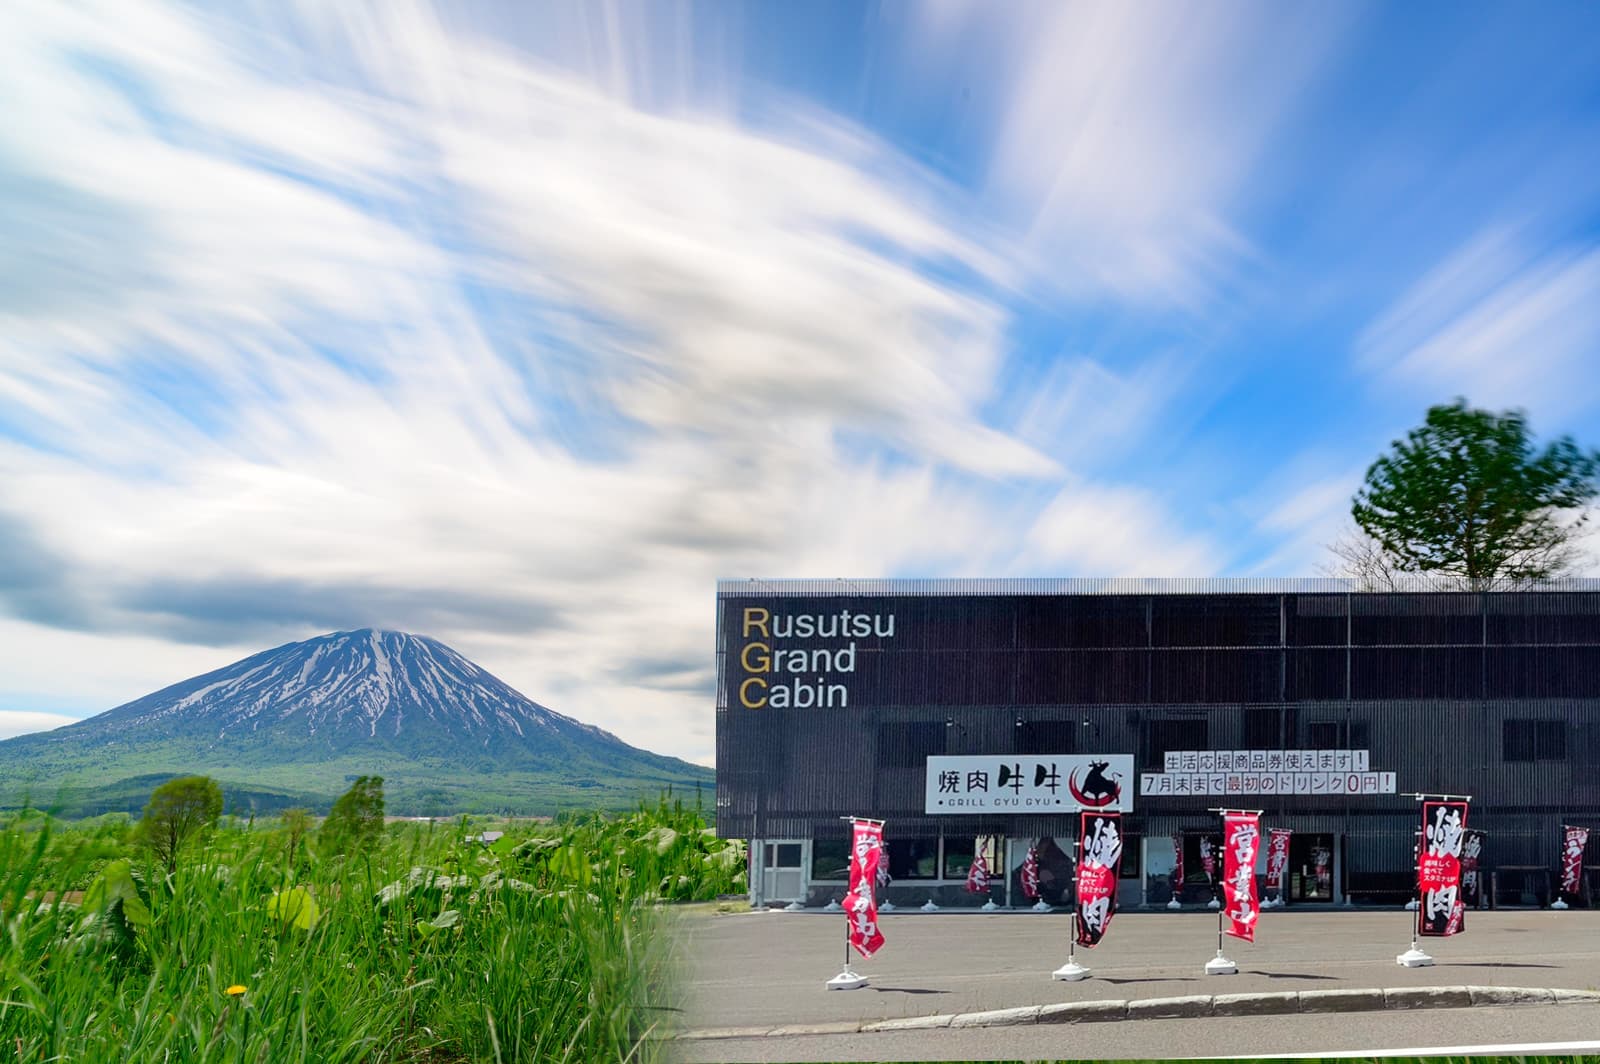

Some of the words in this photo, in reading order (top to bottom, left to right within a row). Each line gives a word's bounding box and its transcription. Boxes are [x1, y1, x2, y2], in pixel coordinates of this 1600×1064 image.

[743, 607, 895, 638] Rusutsu
[740, 642, 856, 673] Grand
[739, 677, 848, 709] Cabin
[948, 798, 986, 806] GRILL
[994, 798, 1020, 806] GYU
[1025, 798, 1051, 806] GYU
[1229, 823, 1258, 933] 営業中
